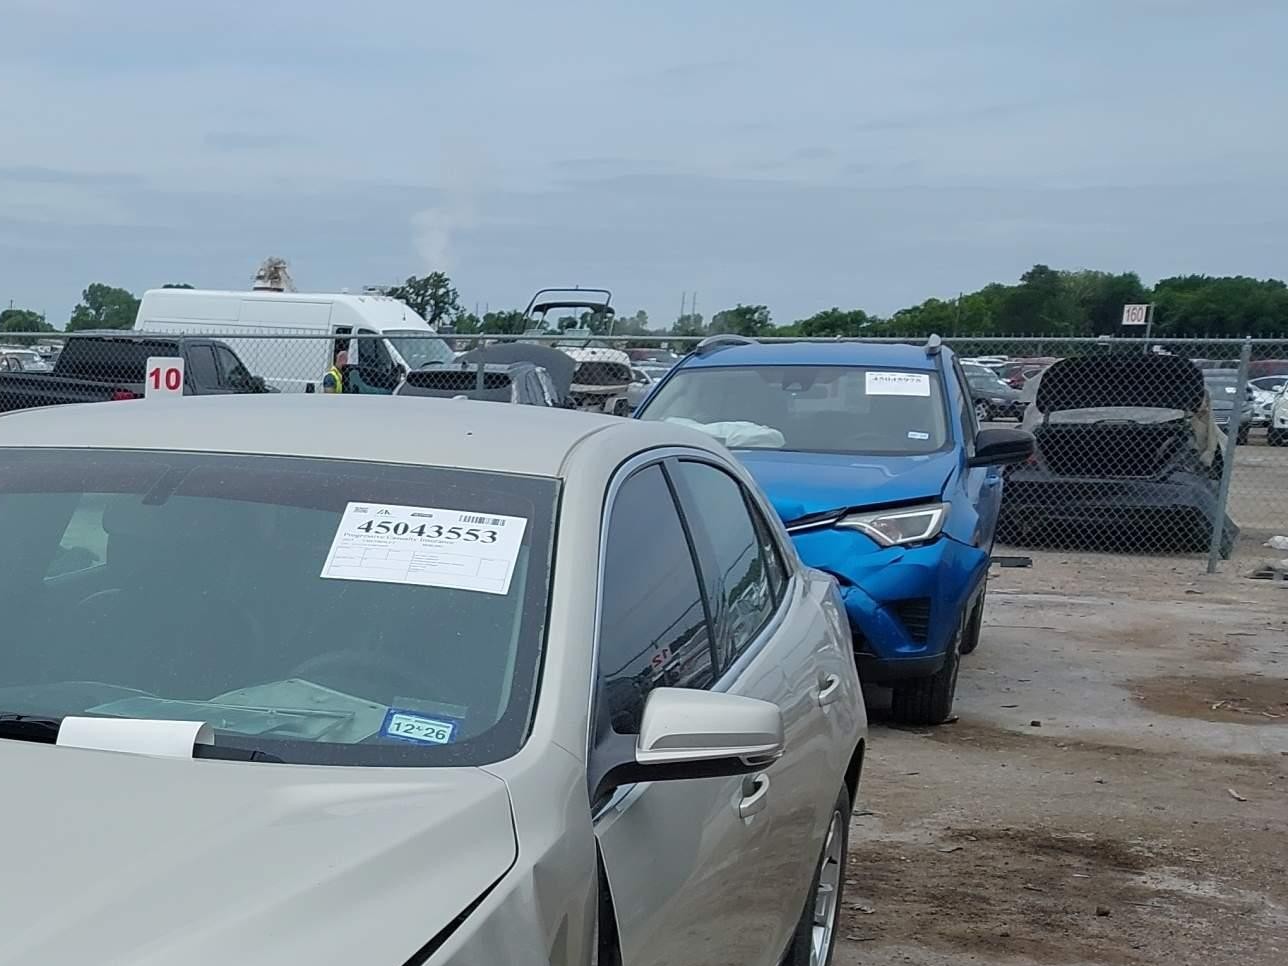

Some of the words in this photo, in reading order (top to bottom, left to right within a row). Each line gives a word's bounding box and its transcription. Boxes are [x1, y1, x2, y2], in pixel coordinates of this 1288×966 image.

[1127, 307, 1144, 322] 160
[149, 367, 182, 391] 10
[357, 519, 498, 544] 45043553
[394, 722, 415, 734] 12
[423, 727, 447, 740] 26
